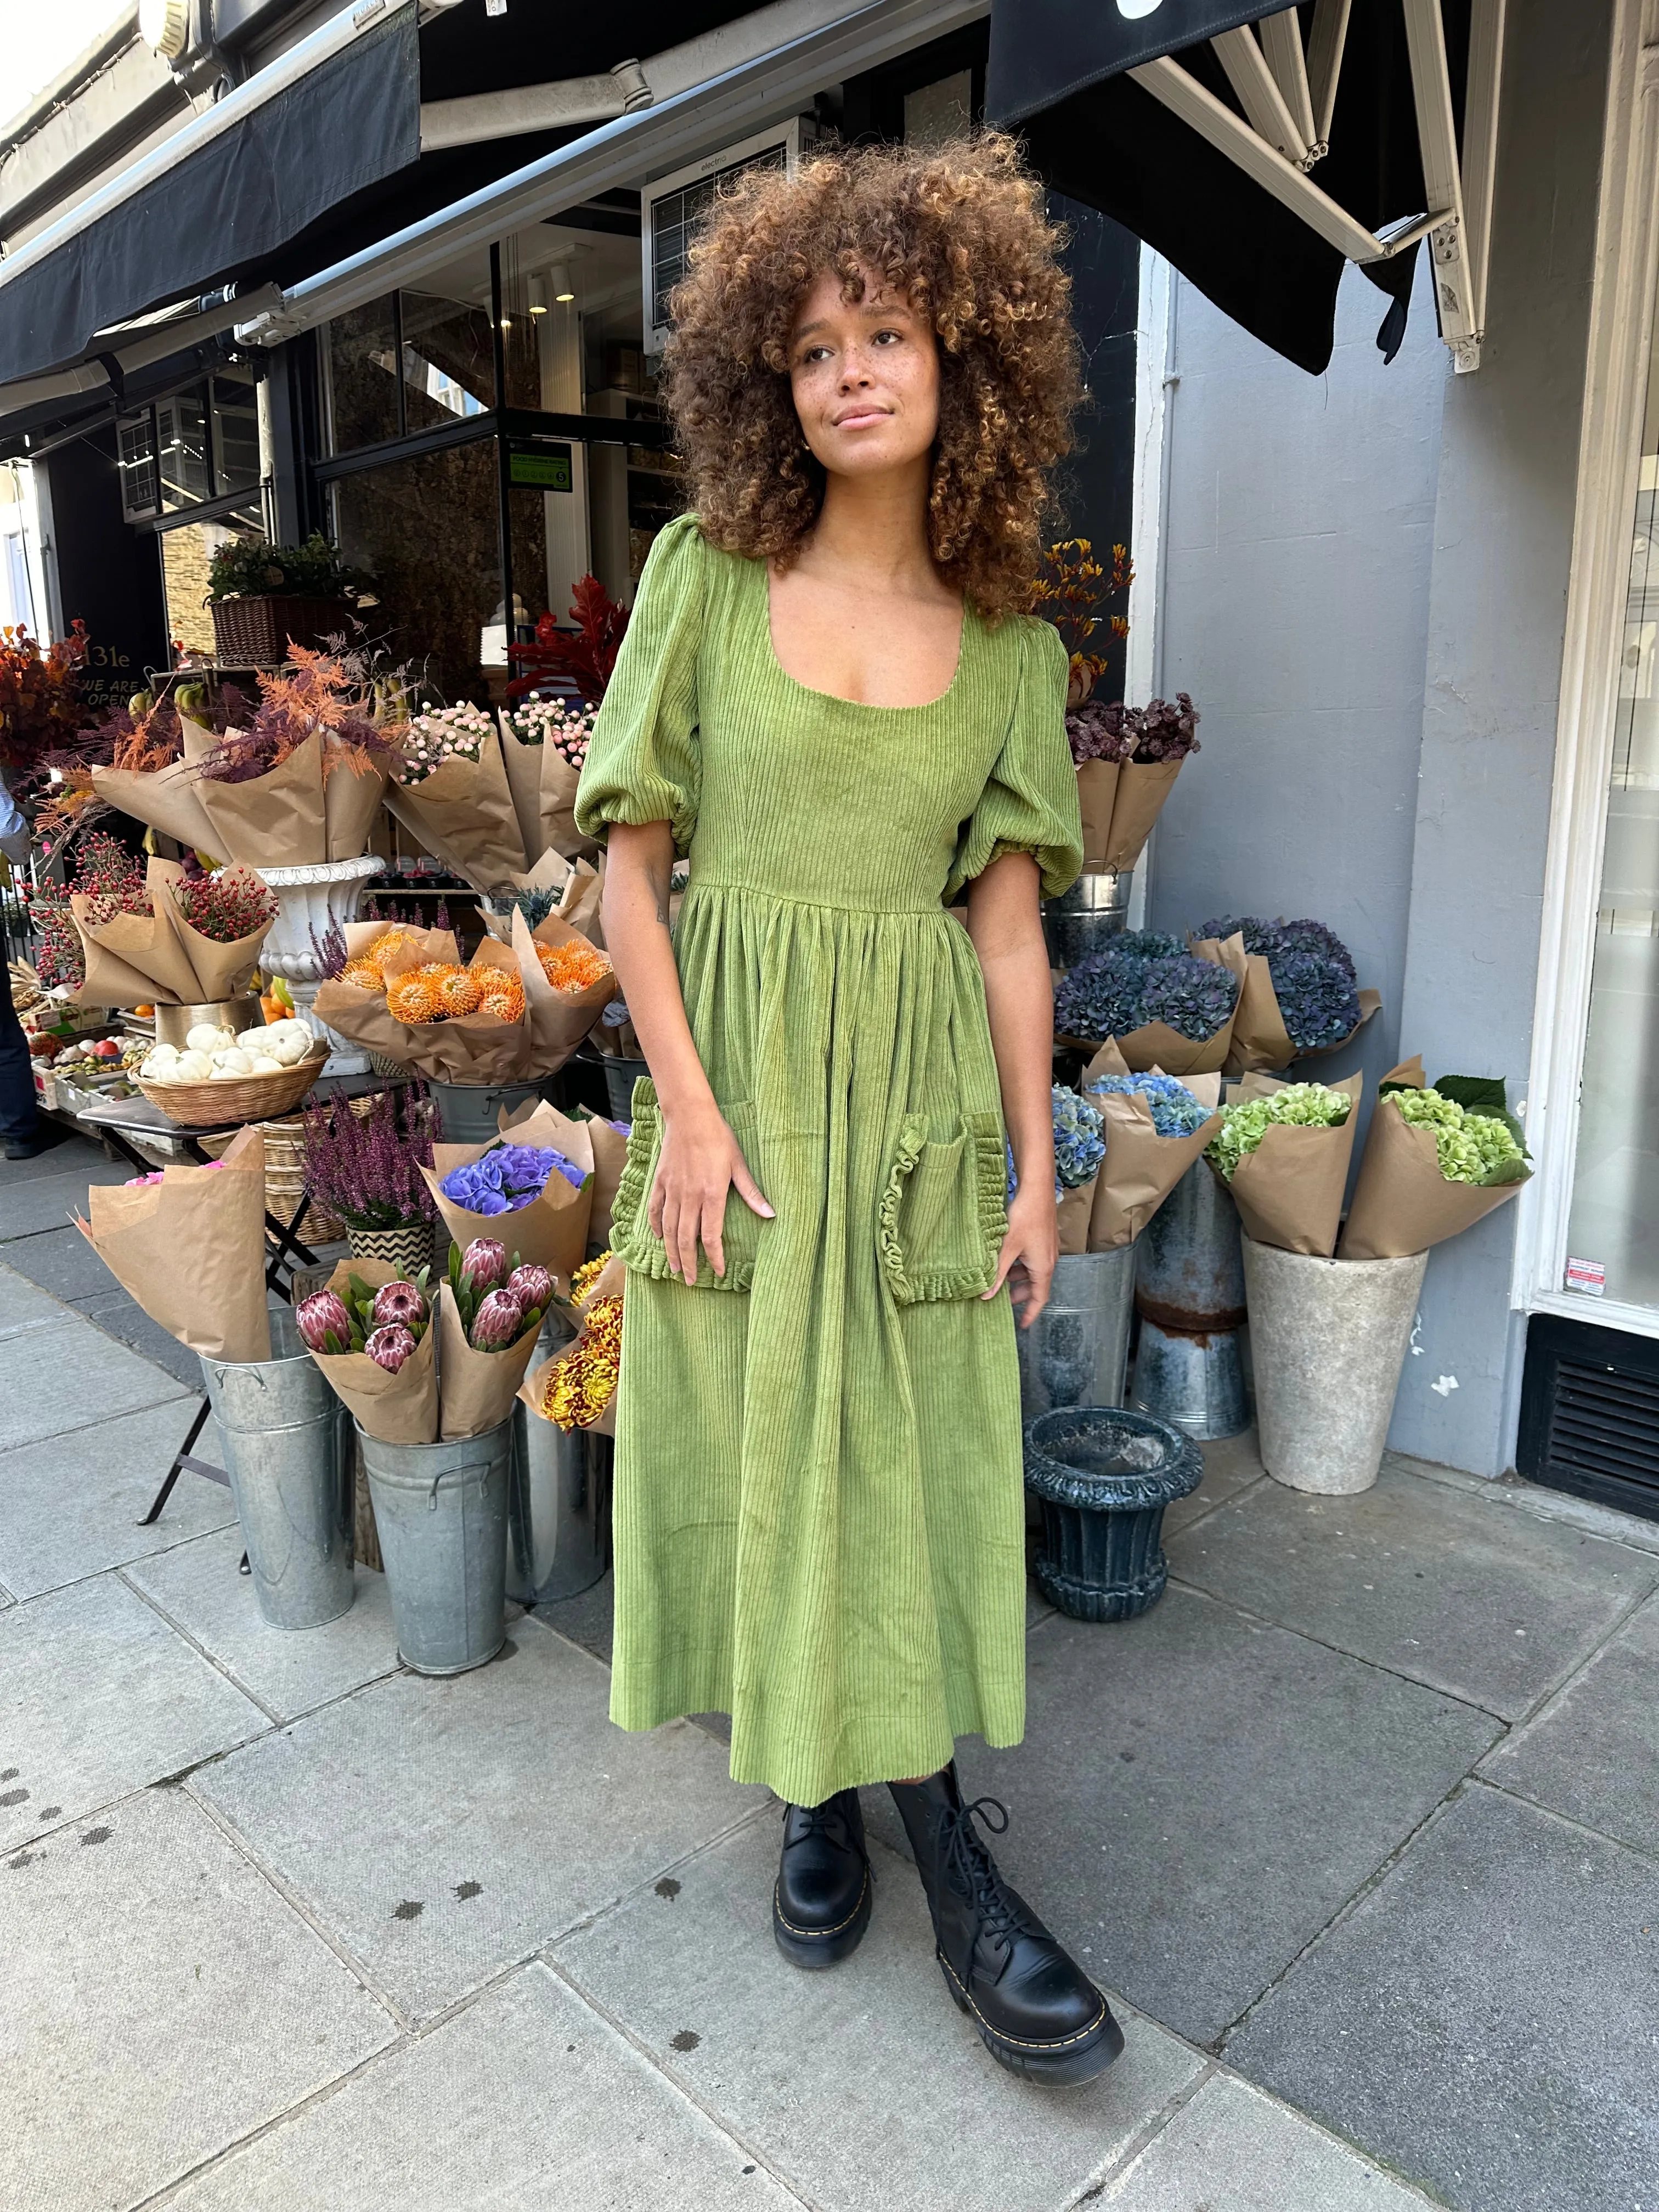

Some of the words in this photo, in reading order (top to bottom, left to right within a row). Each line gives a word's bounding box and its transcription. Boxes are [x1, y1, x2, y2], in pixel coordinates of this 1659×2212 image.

[558, 472, 564, 481] 5
[109, 680, 139, 693] ARE
[88, 693, 130, 706] OPEN
